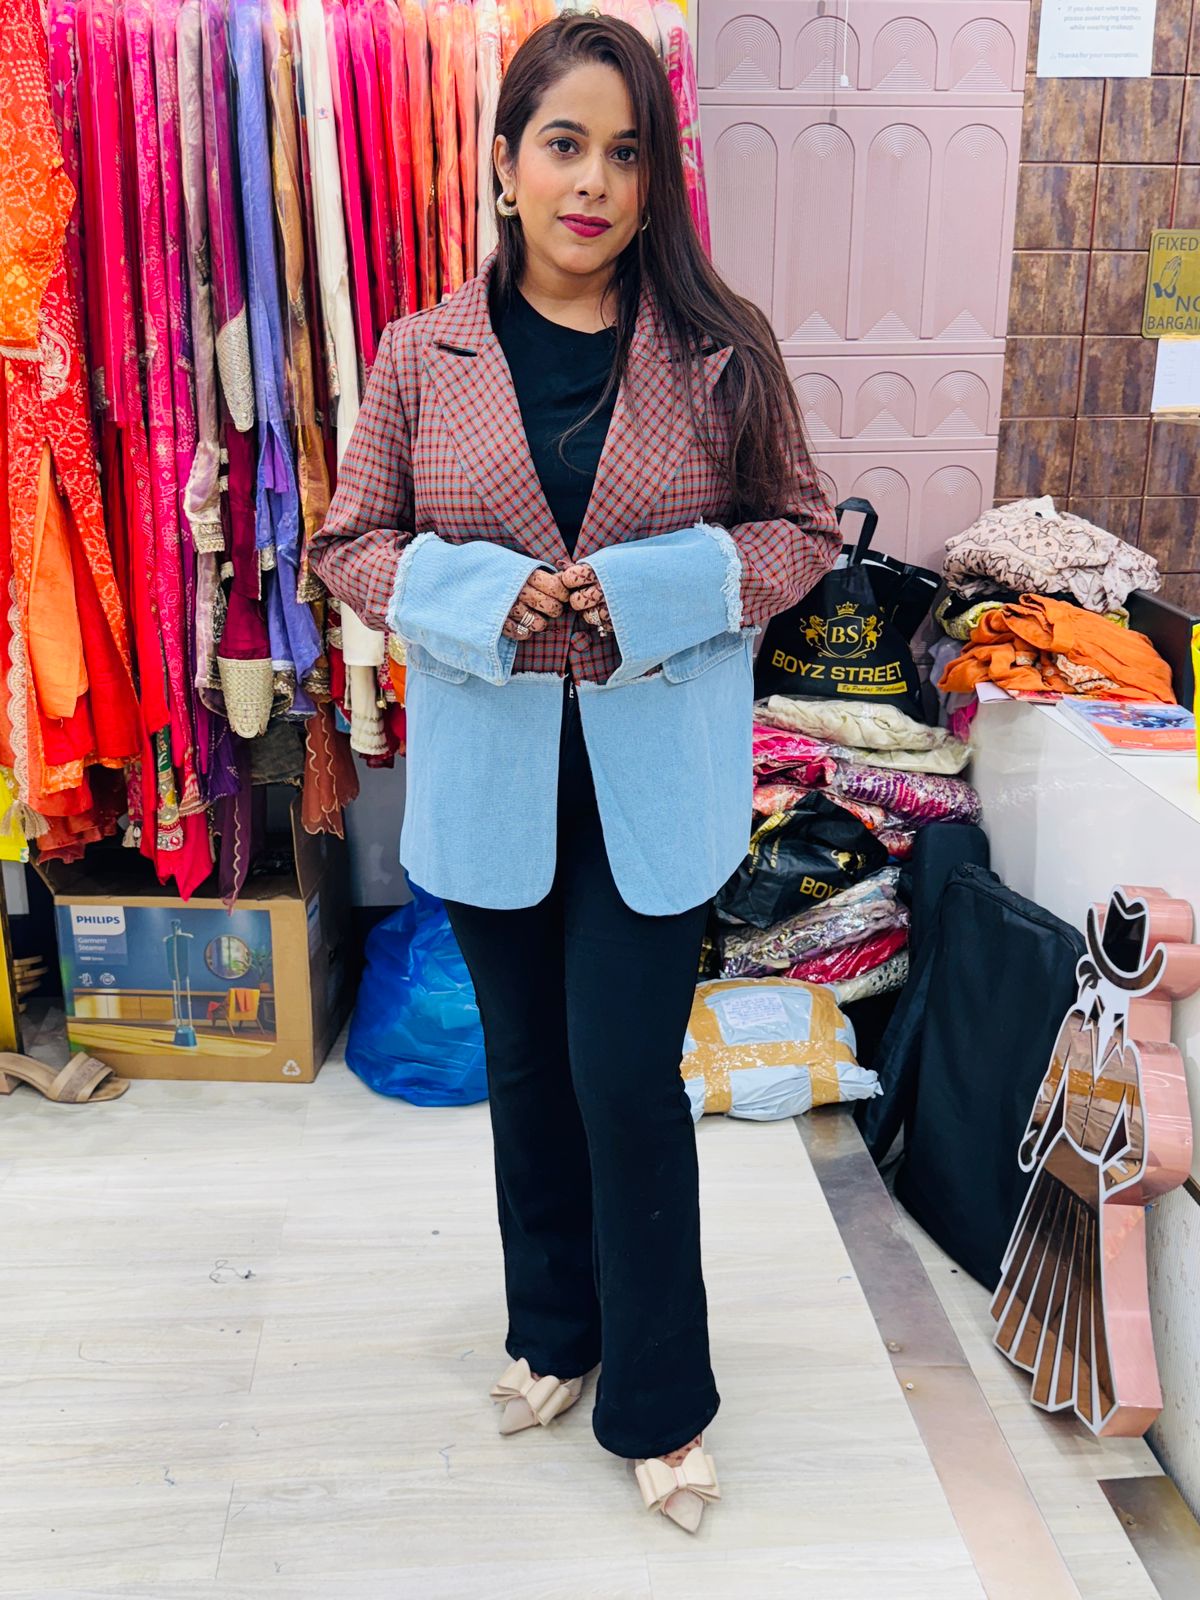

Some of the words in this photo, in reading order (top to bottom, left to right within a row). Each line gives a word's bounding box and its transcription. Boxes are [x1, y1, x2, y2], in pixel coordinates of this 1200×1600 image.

[1157, 236, 1198, 251] FIXED
[1147, 315, 1200, 331] BARGAI
[830, 625, 859, 644] BS
[771, 649, 825, 679] BOYZ
[830, 661, 902, 682] STREET
[76, 915, 120, 925] PHILIPS
